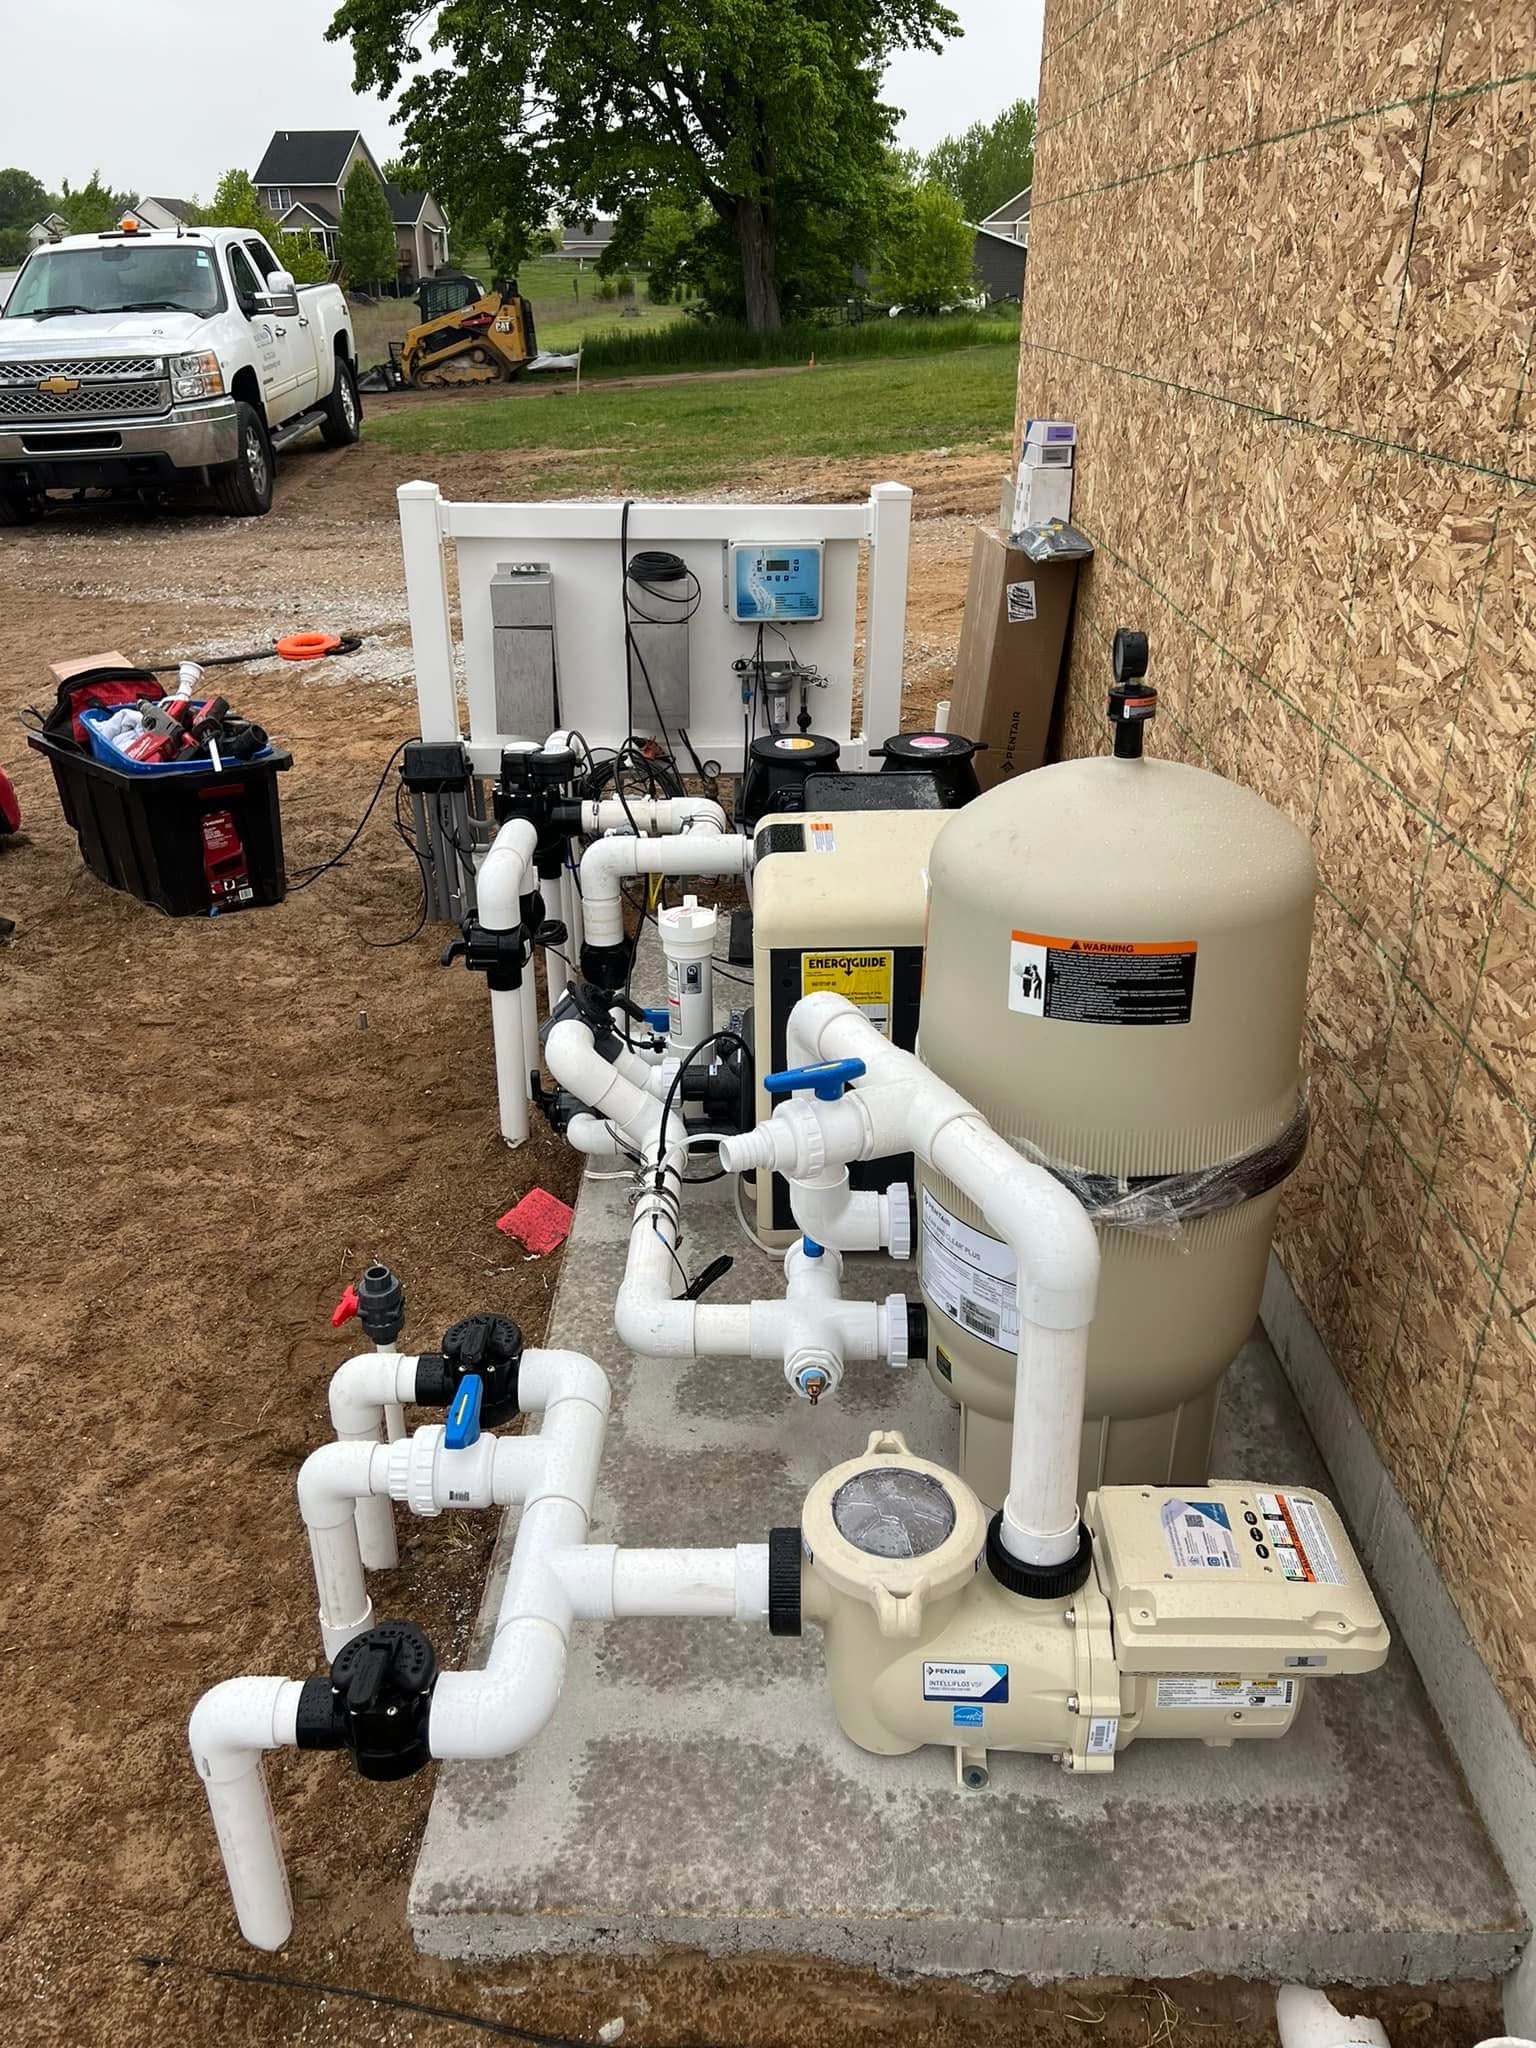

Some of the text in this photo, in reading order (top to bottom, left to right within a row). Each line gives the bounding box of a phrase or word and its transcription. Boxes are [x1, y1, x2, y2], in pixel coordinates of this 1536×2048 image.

[495, 321, 510, 332] CAT
[1006, 711, 1021, 760] PENTAIR
[1082, 943, 1134, 953] WARNING
